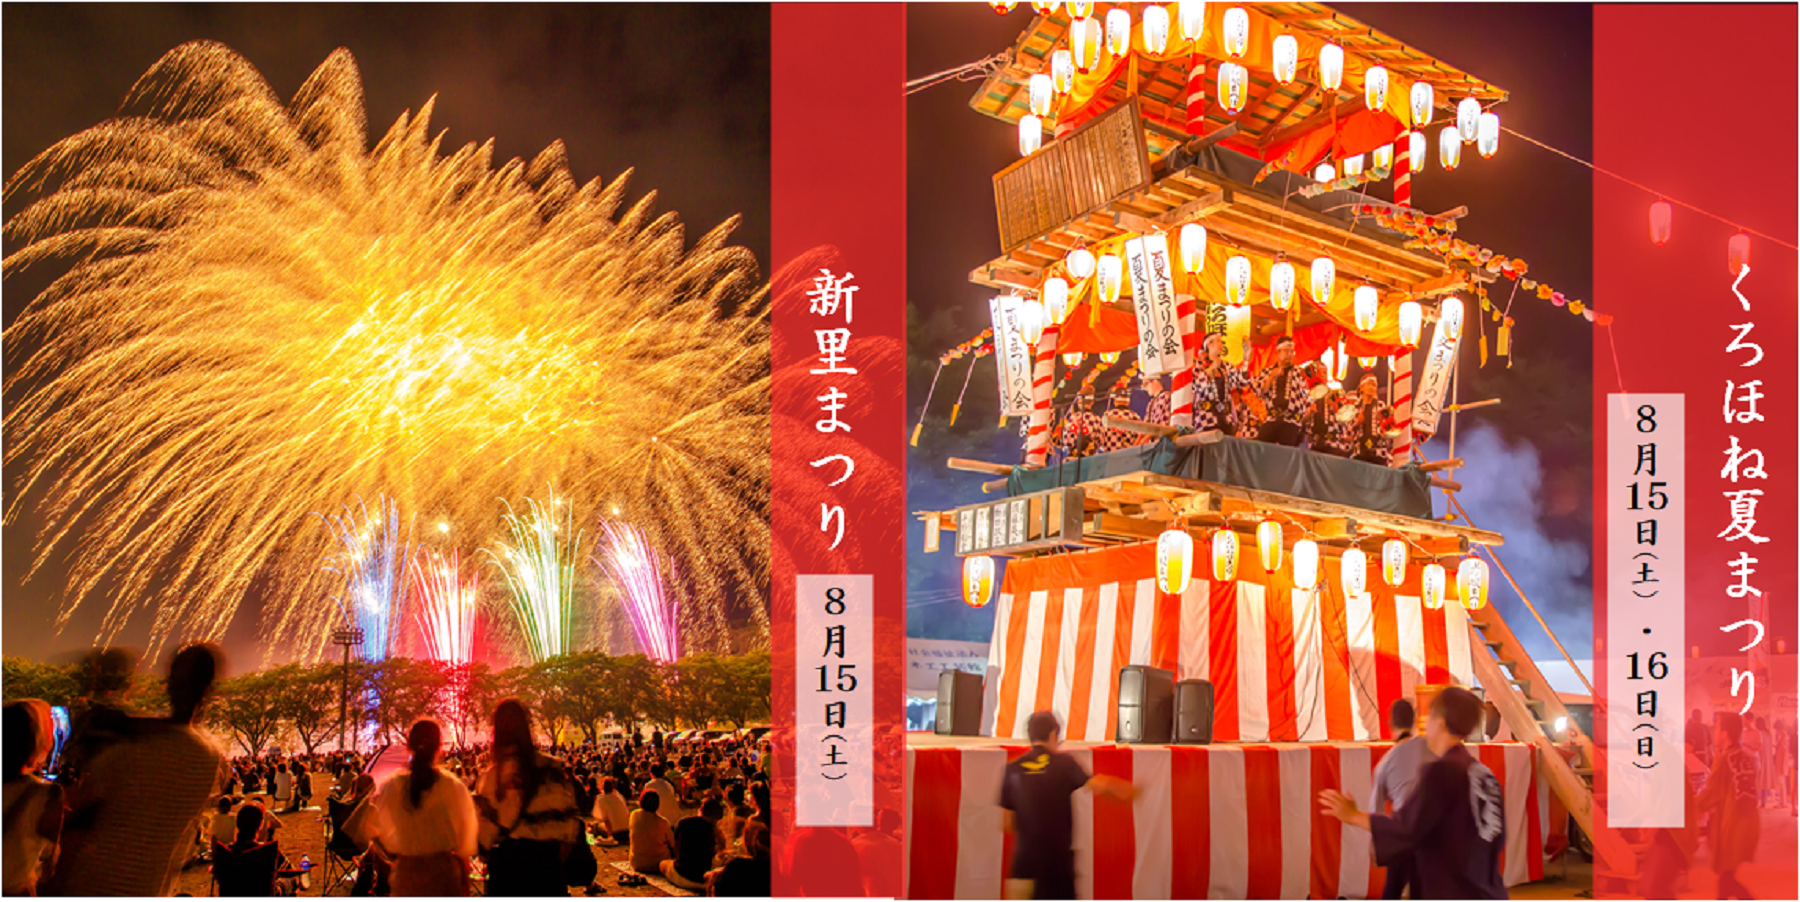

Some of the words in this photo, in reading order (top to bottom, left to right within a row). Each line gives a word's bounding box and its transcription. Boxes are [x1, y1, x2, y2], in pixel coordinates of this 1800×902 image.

[1131, 253, 1159, 360] 夏まつりの会
[1151, 250, 1181, 356] 夏まつりの会
